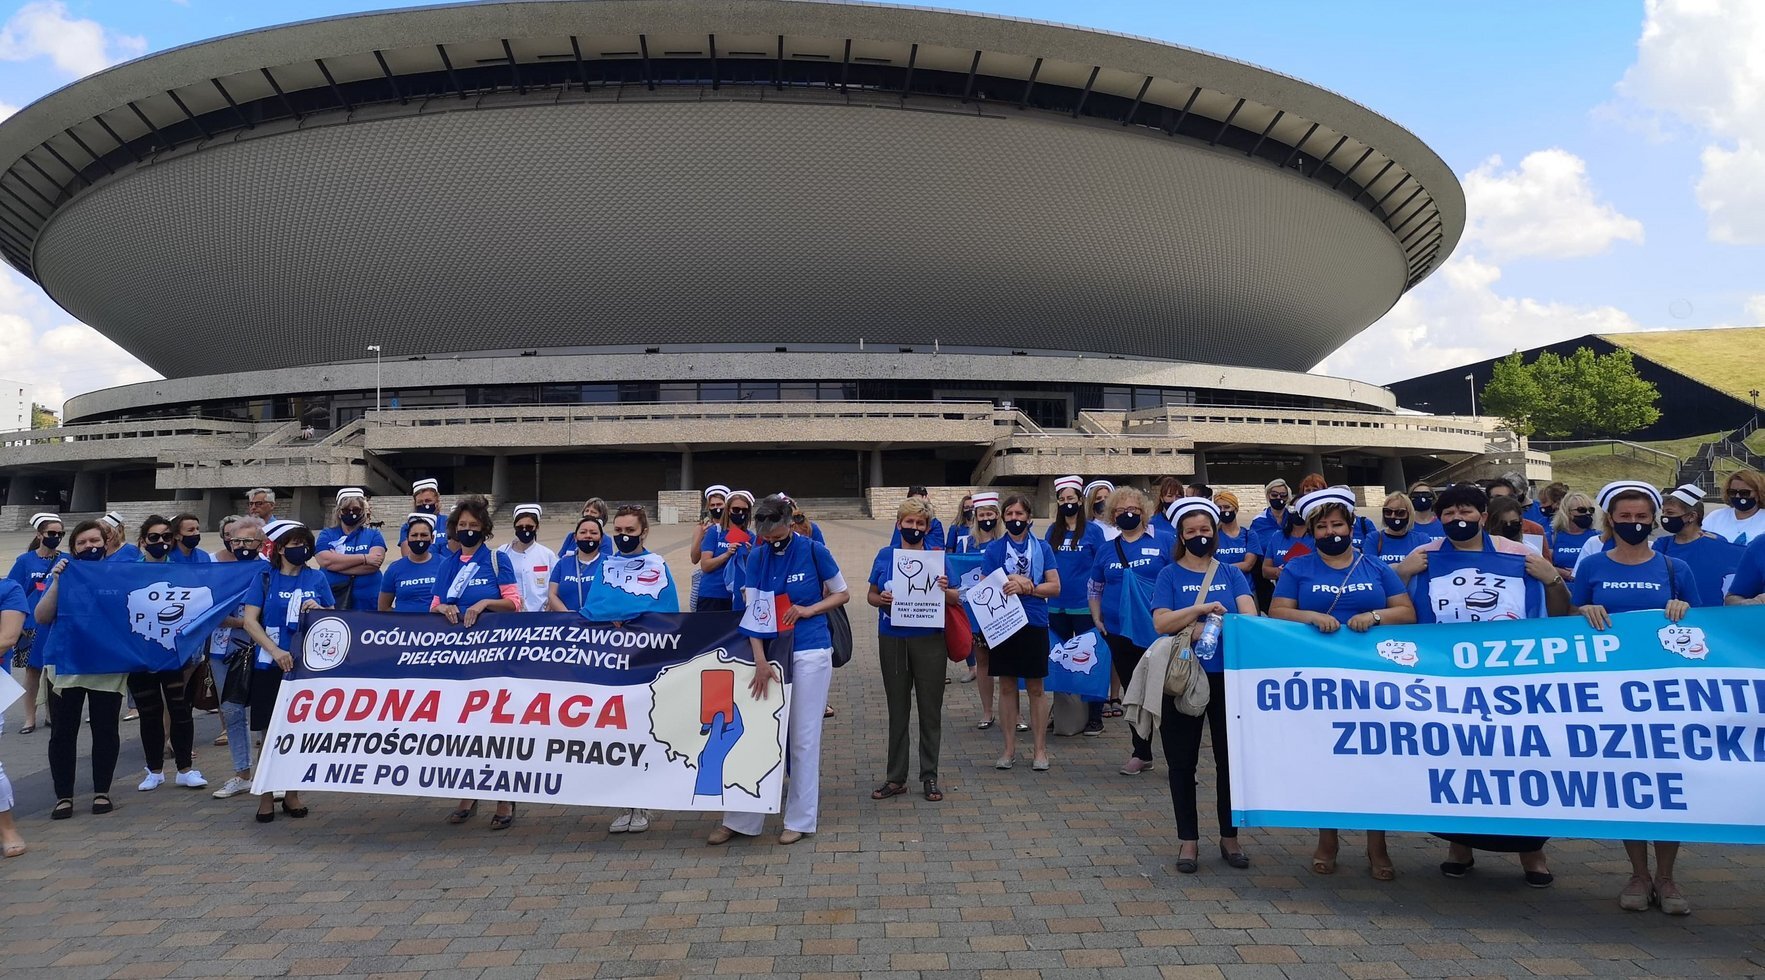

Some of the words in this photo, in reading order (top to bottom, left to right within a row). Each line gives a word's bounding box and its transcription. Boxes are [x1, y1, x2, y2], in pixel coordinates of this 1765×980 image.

[1109, 558, 1151, 569] PRTEST
[400, 577, 436, 587] PROTES
[1182, 584, 1227, 592] PROEST
[1312, 583, 1373, 594] PROTEST
[1602, 581, 1661, 590] PROTEST
[360, 626, 488, 647] OGÓLNOPOLSKI
[488, 626, 567, 644] ZWIĄZEK
[565, 626, 682, 649] ZAWODOWY
[1452, 634, 1621, 669] OZZPiP
[397, 646, 505, 666] PIELĘGNIAREK
[507, 646, 515, 661] I
[517, 645, 630, 670] POŁOŻNYCH
[286, 688, 441, 724] GODNA
[457, 688, 628, 730] PŁACA
[1256, 671, 1603, 722] GÓRNOŚLĄSKIE
[299, 728, 535, 761] WARTOŚCIOWANIU
[545, 738, 649, 771] PRACY,
[1332, 721, 1551, 758] ZDROWIA
[301, 763, 318, 783] A
[324, 763, 368, 784] NIE
[374, 764, 409, 787] PO
[418, 763, 563, 795] UWAŻANIU
[1428, 768, 1688, 811] KATOWICE
